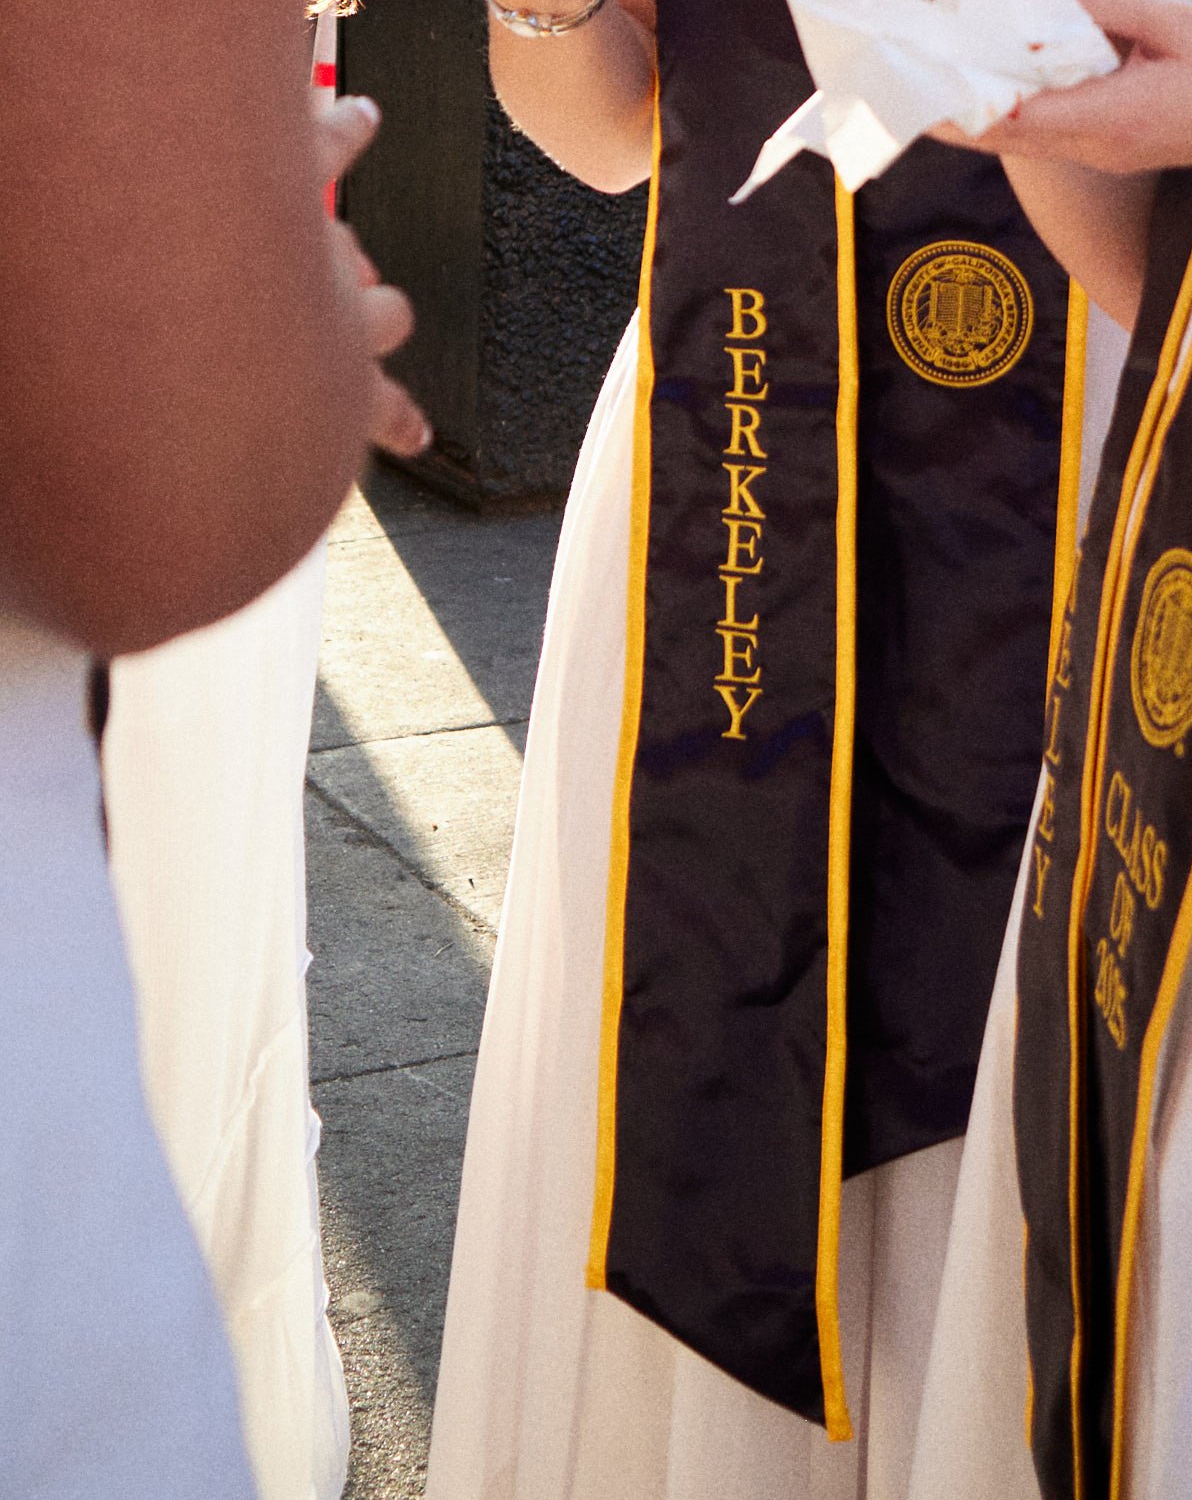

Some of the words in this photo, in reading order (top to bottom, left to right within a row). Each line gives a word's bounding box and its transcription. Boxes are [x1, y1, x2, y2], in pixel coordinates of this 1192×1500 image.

[952, 257, 1012, 300] CALIFORNIA
[714, 288, 768, 740] BERKELEY
[1105, 771, 1167, 911] CLASS
[1110, 871, 1135, 959] OF
